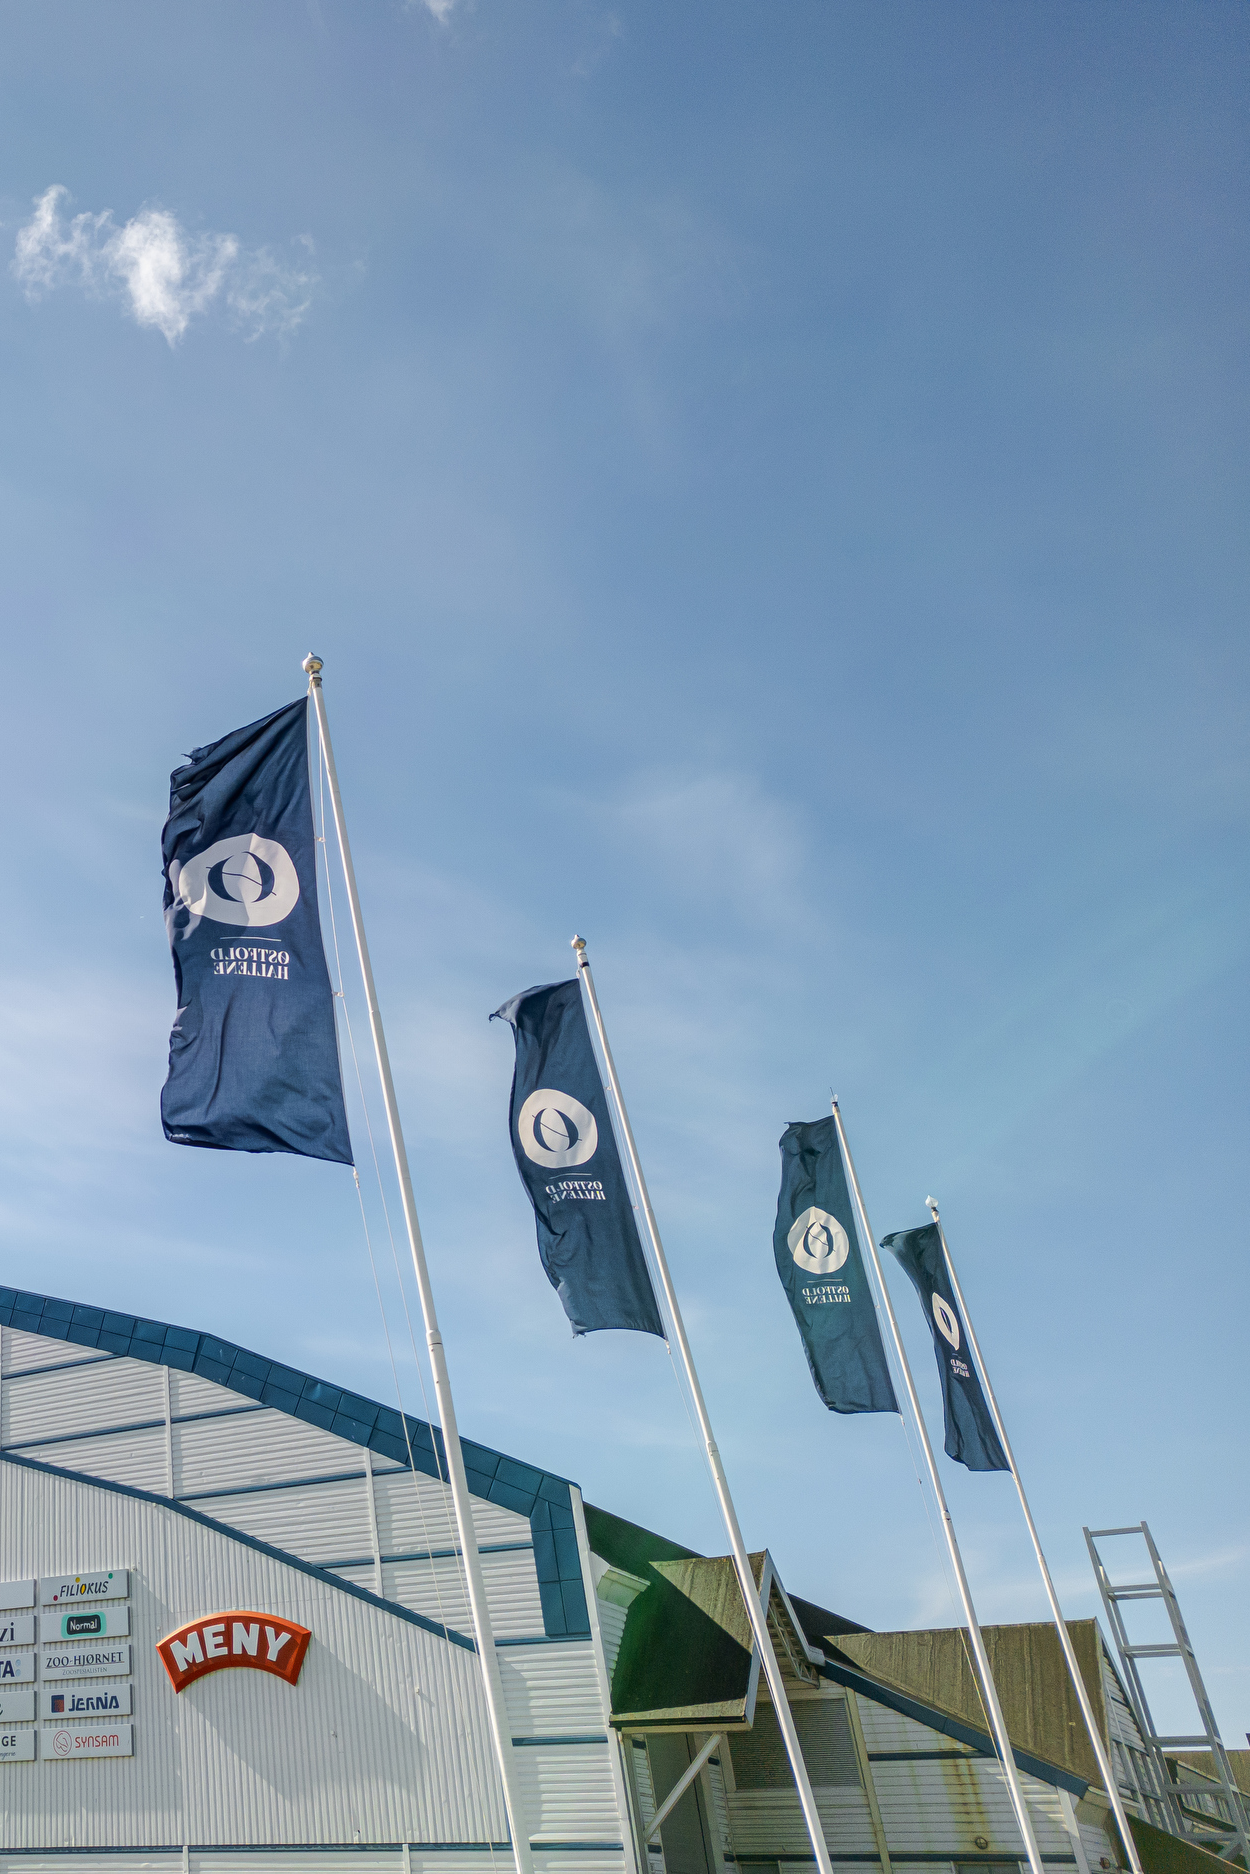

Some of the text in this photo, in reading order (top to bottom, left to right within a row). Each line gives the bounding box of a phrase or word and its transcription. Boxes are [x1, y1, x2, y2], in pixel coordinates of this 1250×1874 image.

[69, 1618, 98, 1632] Normal
[169, 1622, 292, 1672] MENY
[46, 1652, 123, 1668] ZOO-HJØRNET
[75, 1735, 119, 1748] SYNSAM
